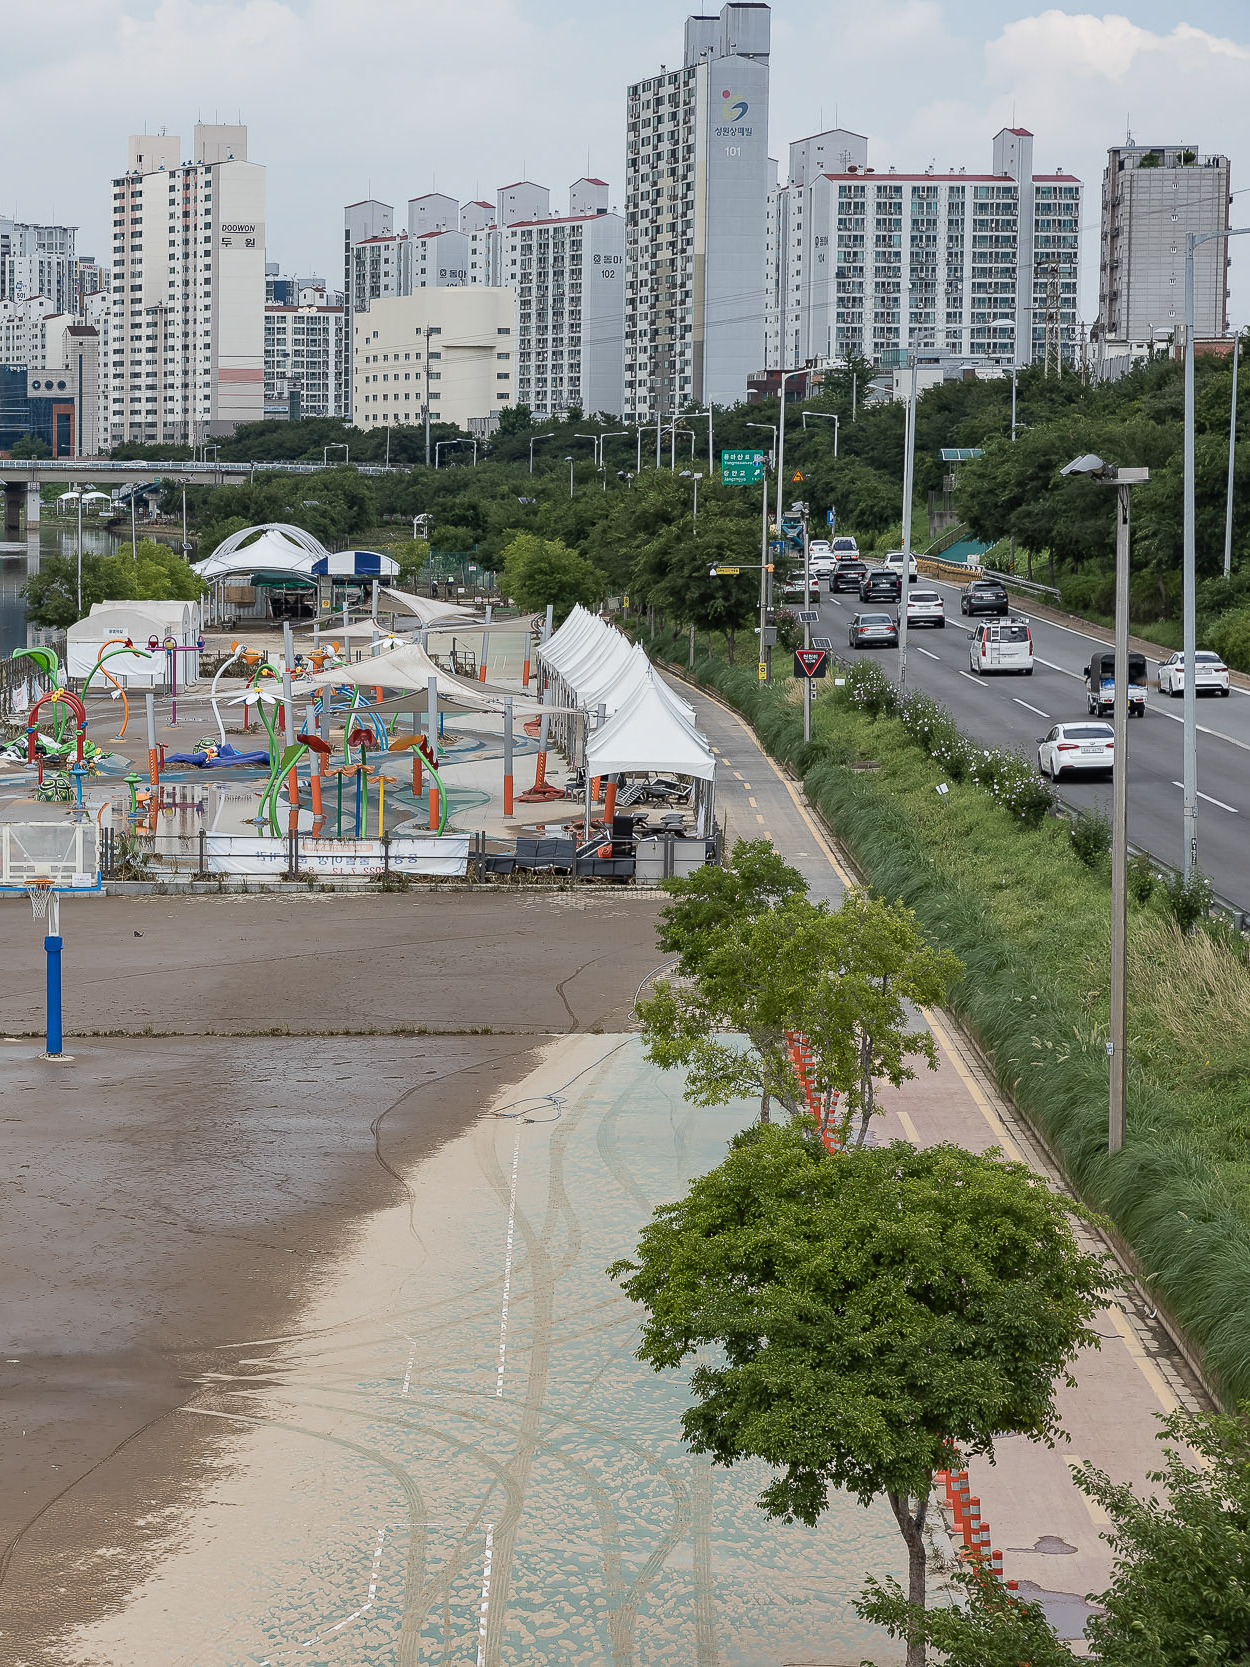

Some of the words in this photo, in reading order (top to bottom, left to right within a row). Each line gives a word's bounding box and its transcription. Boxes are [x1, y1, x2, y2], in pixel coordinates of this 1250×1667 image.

[725, 146, 741, 157] 101
[222, 224, 255, 232] DOOWON
[603, 255, 623, 264] 동아
[601, 270, 615, 279] 102
